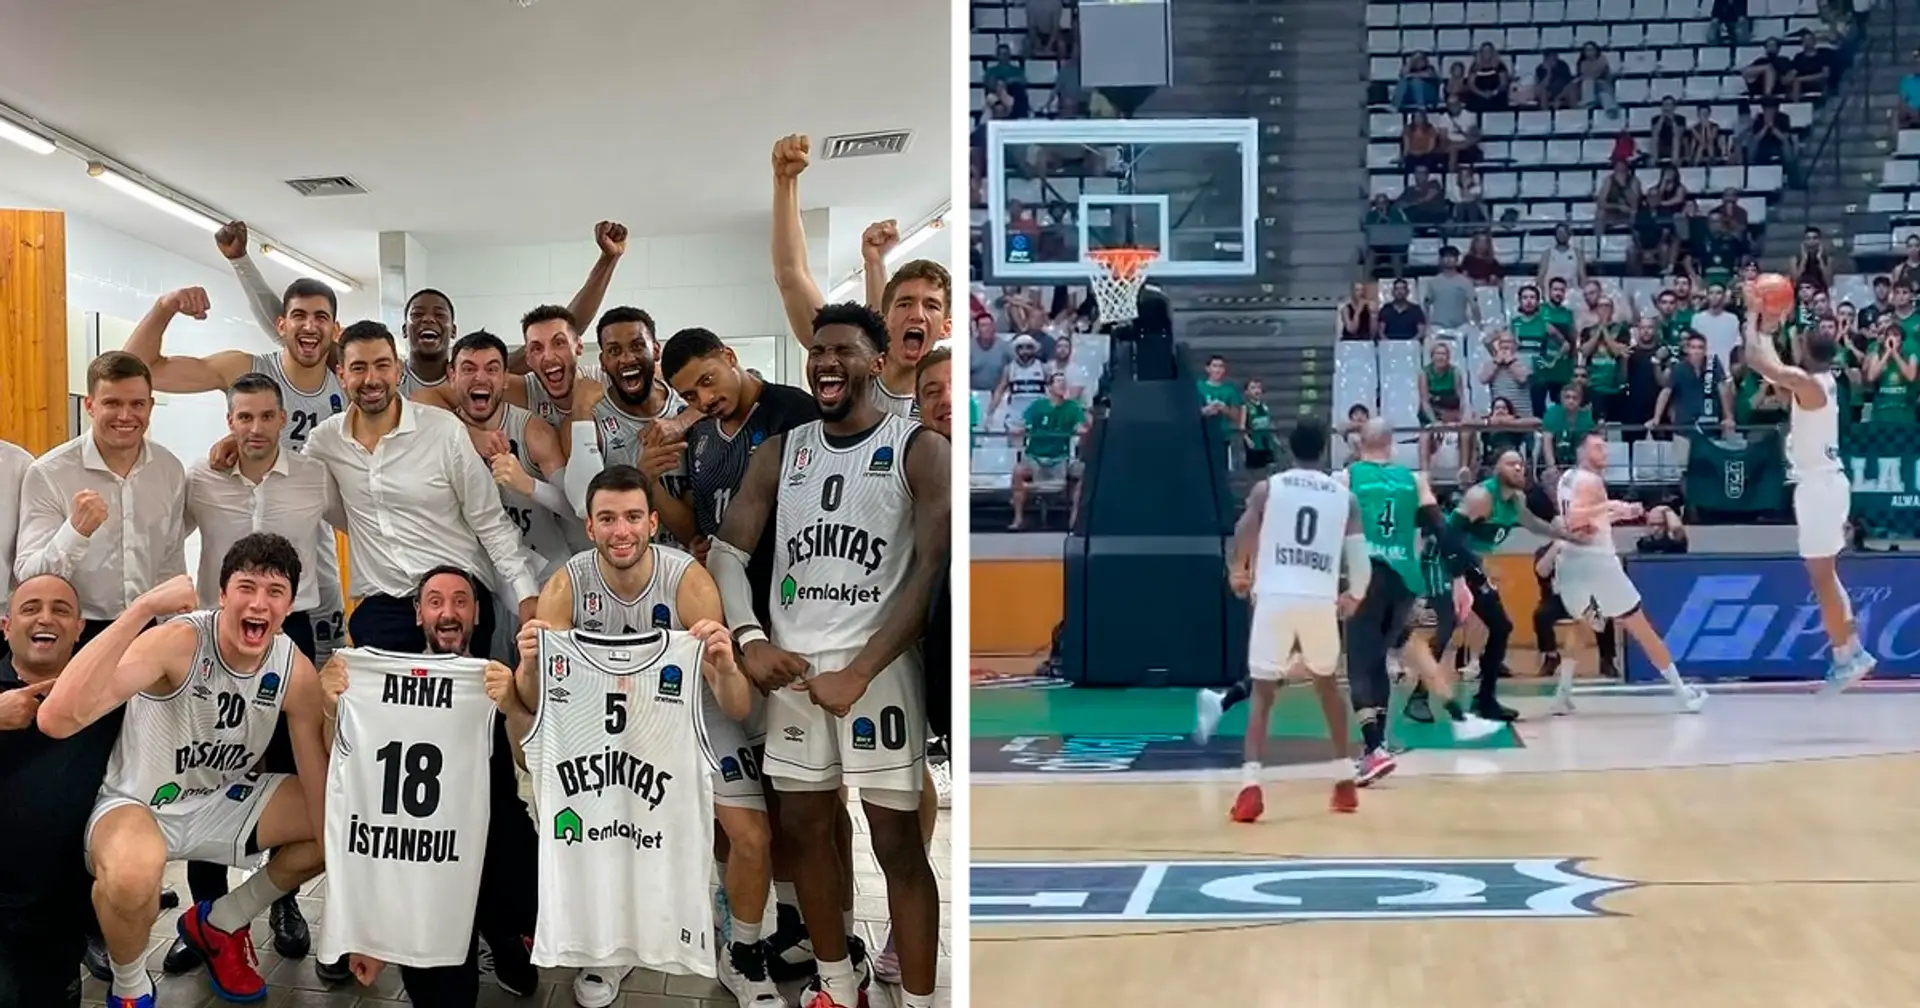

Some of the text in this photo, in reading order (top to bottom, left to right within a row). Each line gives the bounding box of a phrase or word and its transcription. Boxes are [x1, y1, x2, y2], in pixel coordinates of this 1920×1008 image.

[290, 409, 317, 441] 21
[821, 474, 845, 512] 0
[1295, 506, 1319, 547] 0
[1376, 498, 1396, 539] 4
[797, 583, 882, 606] emlakjet
[214, 691, 246, 729] 20
[382, 673, 454, 709] ARNA
[604, 692, 627, 735] 5
[880, 705, 907, 750] 0
[376, 740, 443, 818] 18
[556, 745, 674, 811] BEŞİKTAŞ
[348, 814, 459, 863] İSTANBUL
[588, 819, 663, 850] emlakjet
